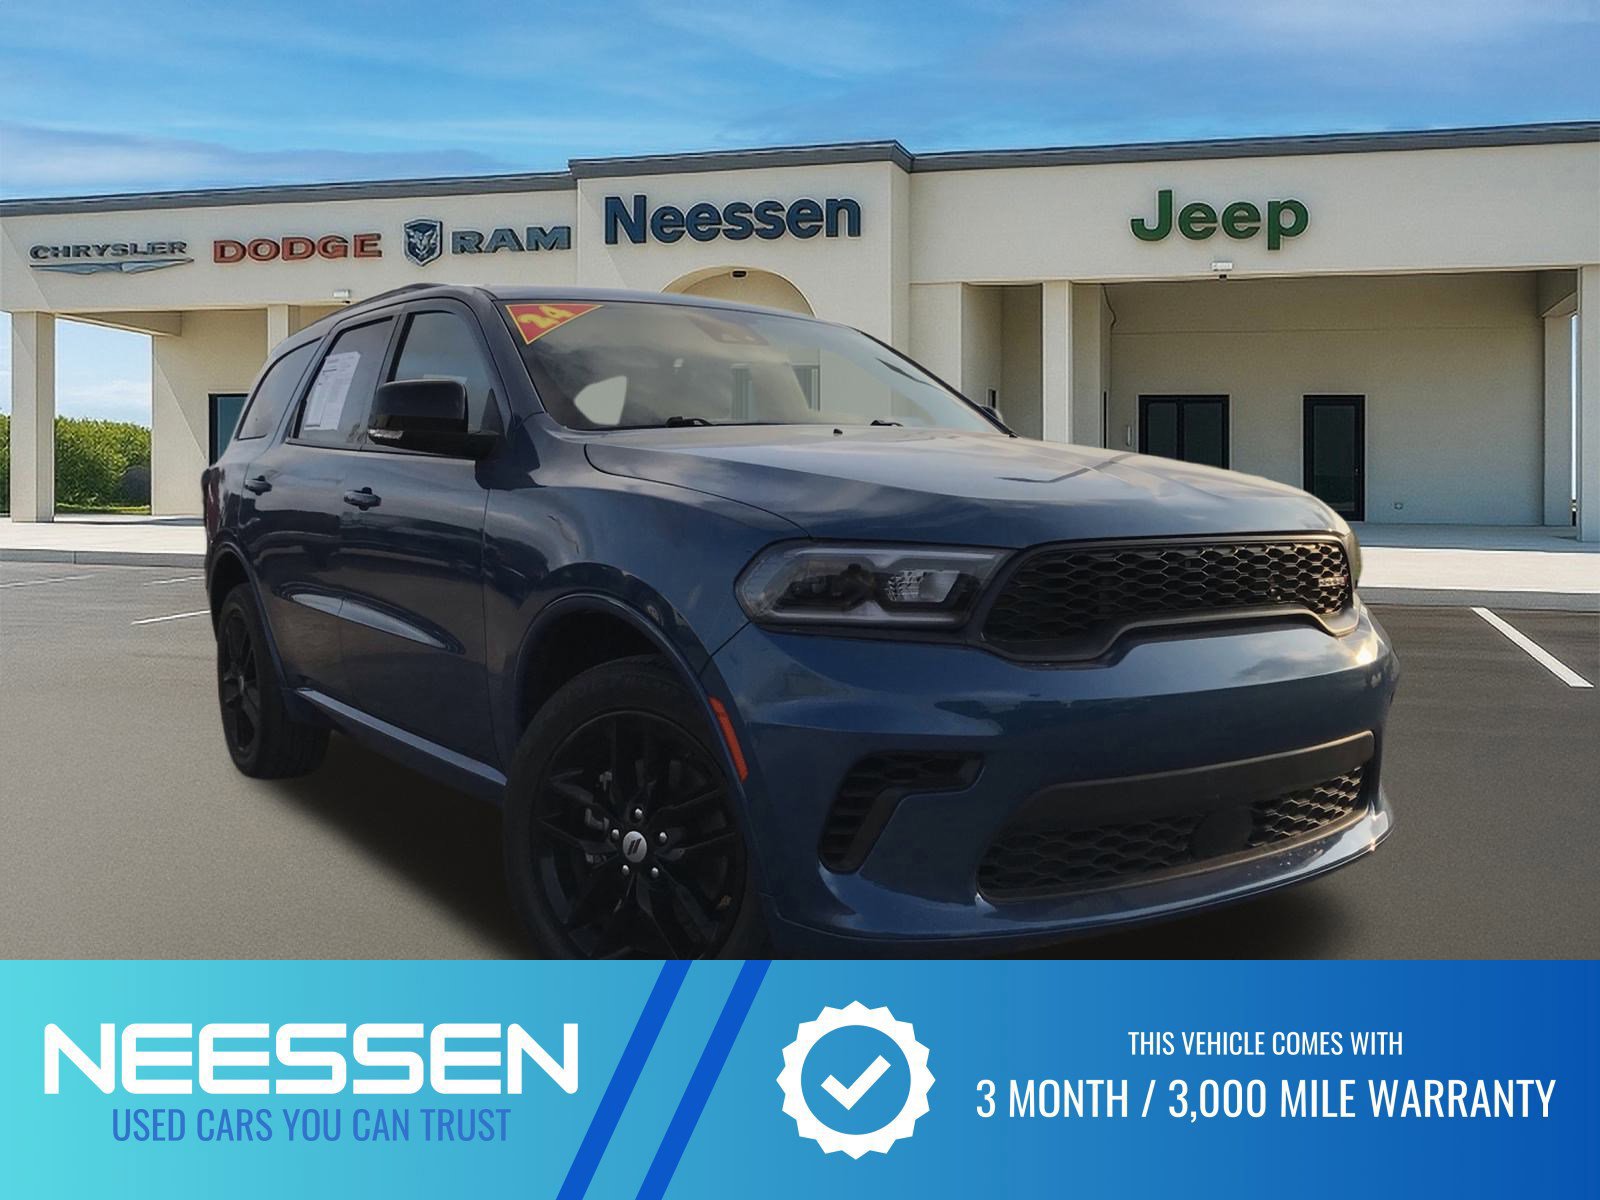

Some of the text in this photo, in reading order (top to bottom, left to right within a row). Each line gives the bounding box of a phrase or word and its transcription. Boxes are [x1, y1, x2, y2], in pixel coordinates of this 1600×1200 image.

[604, 194, 862, 245] Neessen
[1130, 189, 1309, 251] Jeep
[29, 240, 188, 260] CHRYSLER
[212, 233, 382, 264] DODGE
[451, 226, 571, 254] RAM
[517, 304, 577, 329] 24
